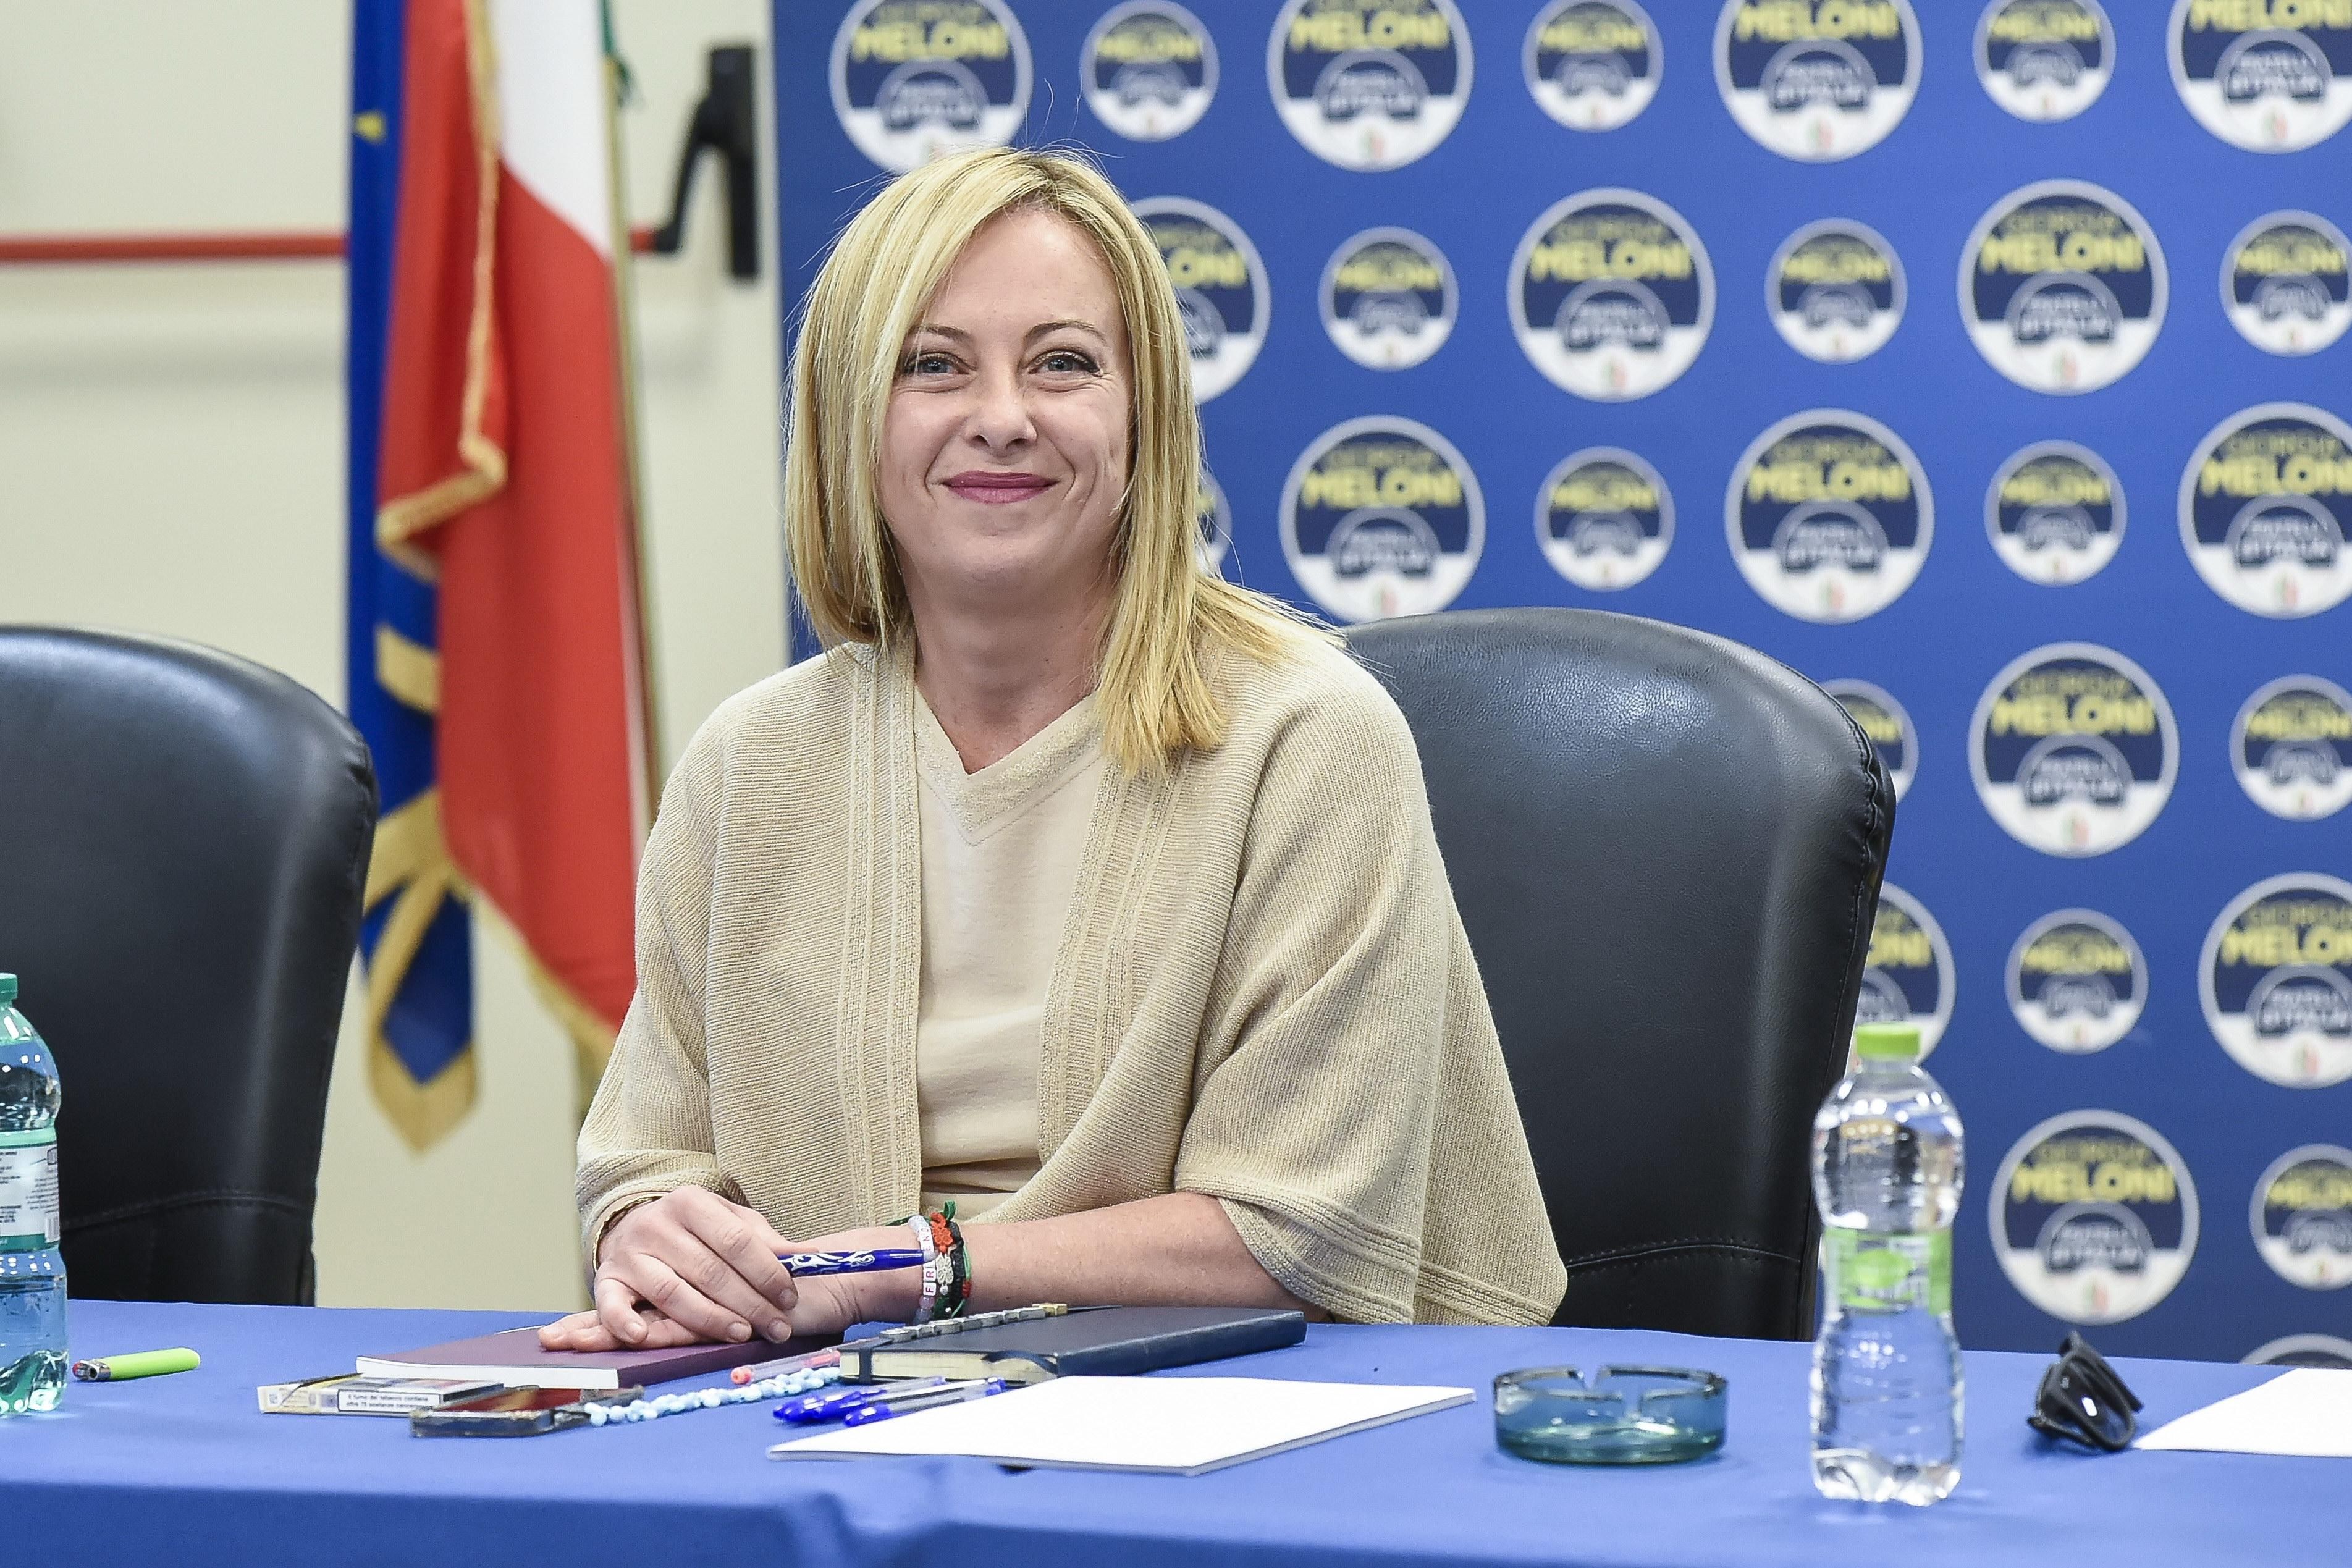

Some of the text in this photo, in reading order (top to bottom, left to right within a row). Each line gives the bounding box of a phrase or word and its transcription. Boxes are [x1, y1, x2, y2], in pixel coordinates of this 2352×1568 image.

[853, 21, 1008, 61] MELONI
[1291, 11, 1449, 51] MELONI
[1737, 0, 1899, 41] MELONI
[1530, 239, 1692, 281] MELONI
[1981, 232, 2144, 273] MELONI
[1304, 465, 1462, 508] MELONI
[1749, 460, 1910, 502] MELONI
[1991, 694, 2156, 736] MELONI
[2012, 1161, 2176, 1203] MELONI
